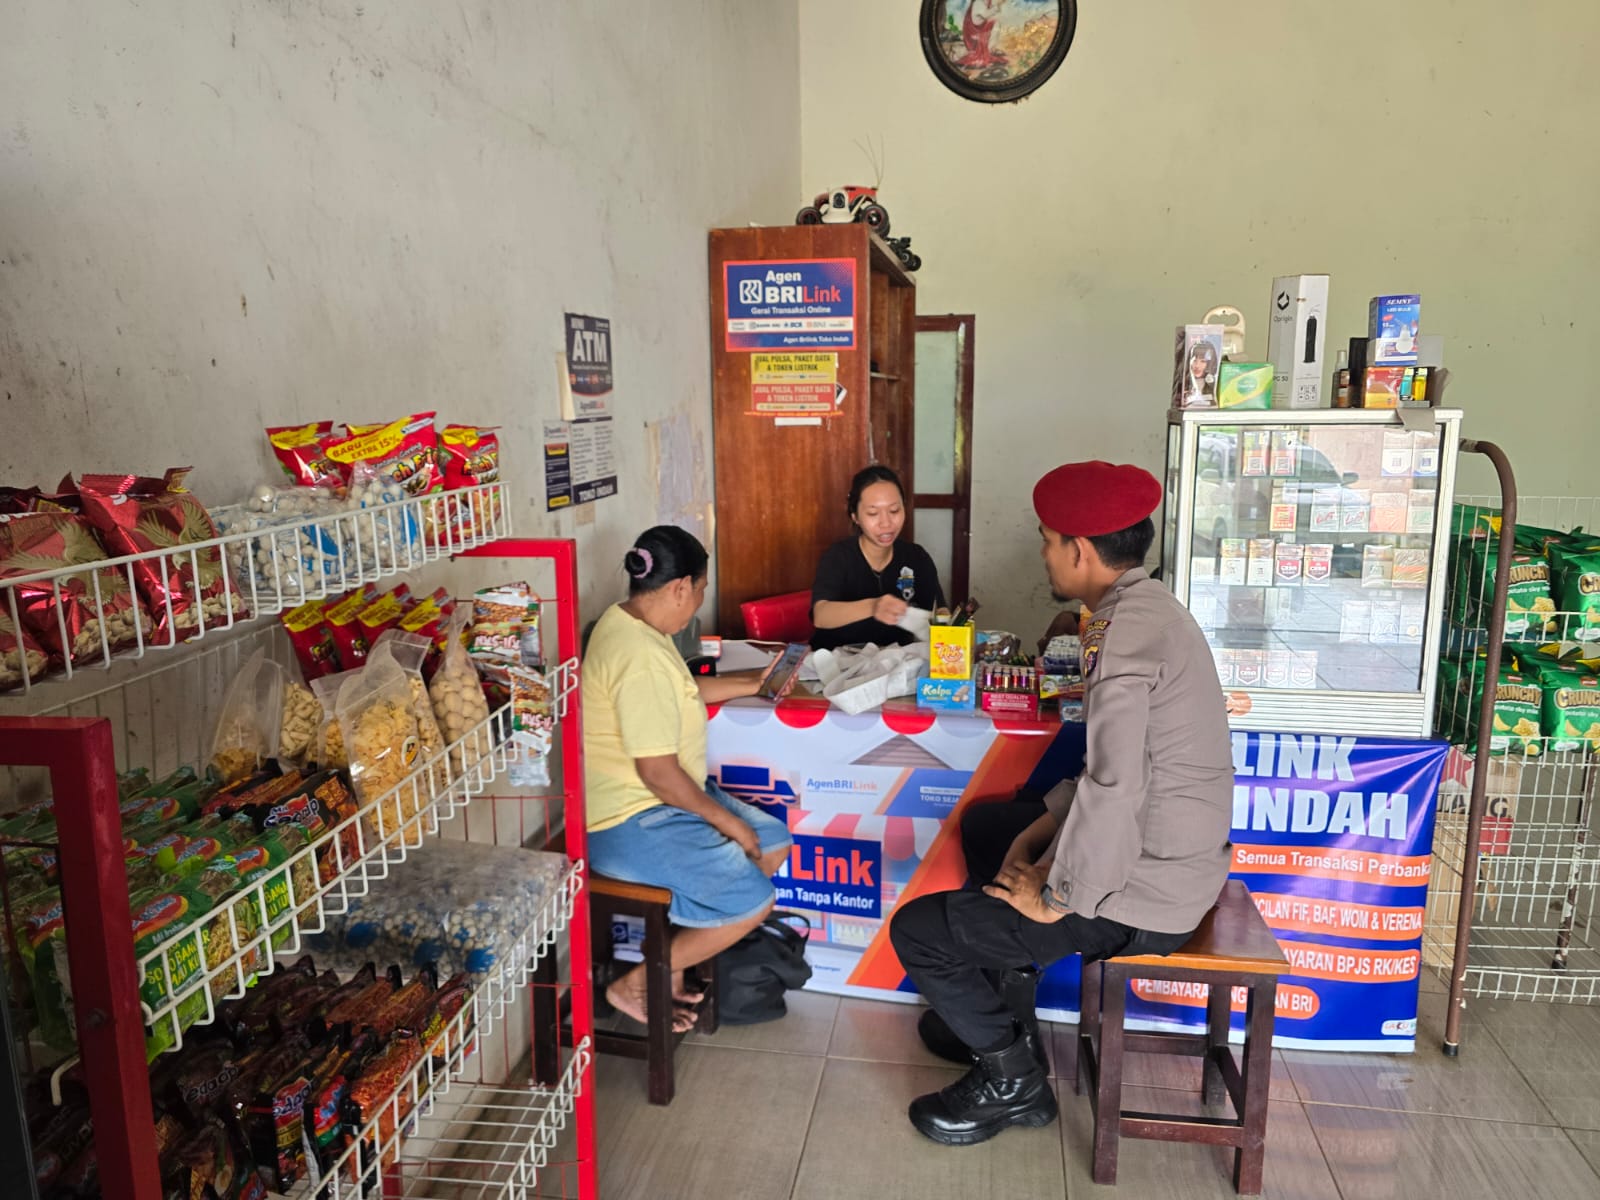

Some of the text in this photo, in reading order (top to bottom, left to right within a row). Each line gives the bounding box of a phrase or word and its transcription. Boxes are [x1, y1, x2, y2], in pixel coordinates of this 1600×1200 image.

[765, 270, 802, 284] Agen
[765, 285, 842, 304] BRILink
[772, 306, 806, 315] Transaksi
[807, 305, 831, 314] Online
[572, 330, 608, 363] ATM
[332, 441, 362, 458] BARU
[379, 435, 401, 449] 15%
[1509, 565, 1549, 583] RUNCH
[923, 684, 952, 697] Kalpa
[1495, 687, 1541, 707] RUNCHY
[1556, 688, 1600, 708] CRUNC
[807, 778, 878, 791] AgenBRILink
[1231, 786, 1409, 840] INDAH
[1236, 849, 1286, 865] Semua
[1290, 851, 1364, 873] Transaksi
[795, 887, 831, 907] Tanpa
[833, 892, 874, 909] Kantor
[1256, 898, 1422, 930] CILAN FIF, BAF, WOM & VERENA
[146, 957, 177, 985] SOO
[1336, 954, 1371, 975] BPJS
[1373, 955, 1417, 975] RK/KES
[1137, 978, 1209, 999] PEMBAYARA
[1291, 995, 1313, 1012] BRI
